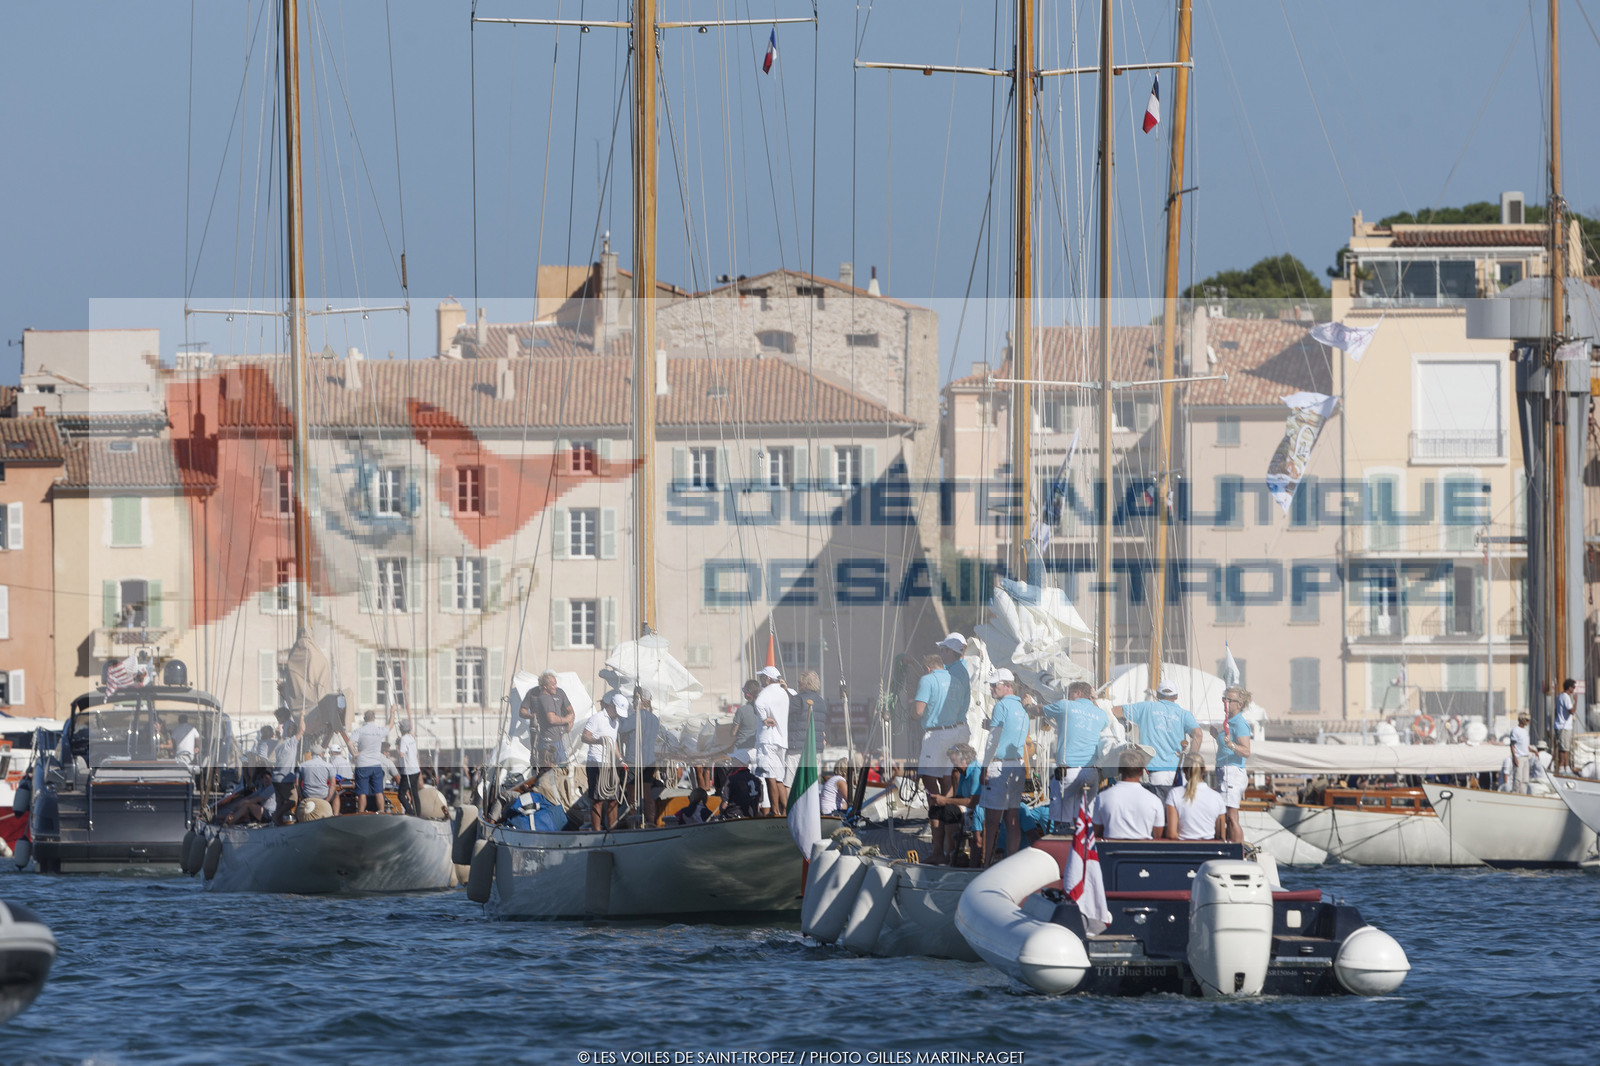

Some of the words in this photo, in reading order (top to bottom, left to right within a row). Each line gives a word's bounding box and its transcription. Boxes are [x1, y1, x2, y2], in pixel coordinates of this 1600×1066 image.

[747, 779, 759, 796] 1
[1096, 966, 1115, 977] T/T
[1117, 966, 1142, 977] Blue
[1144, 966, 1167, 977] Bird
